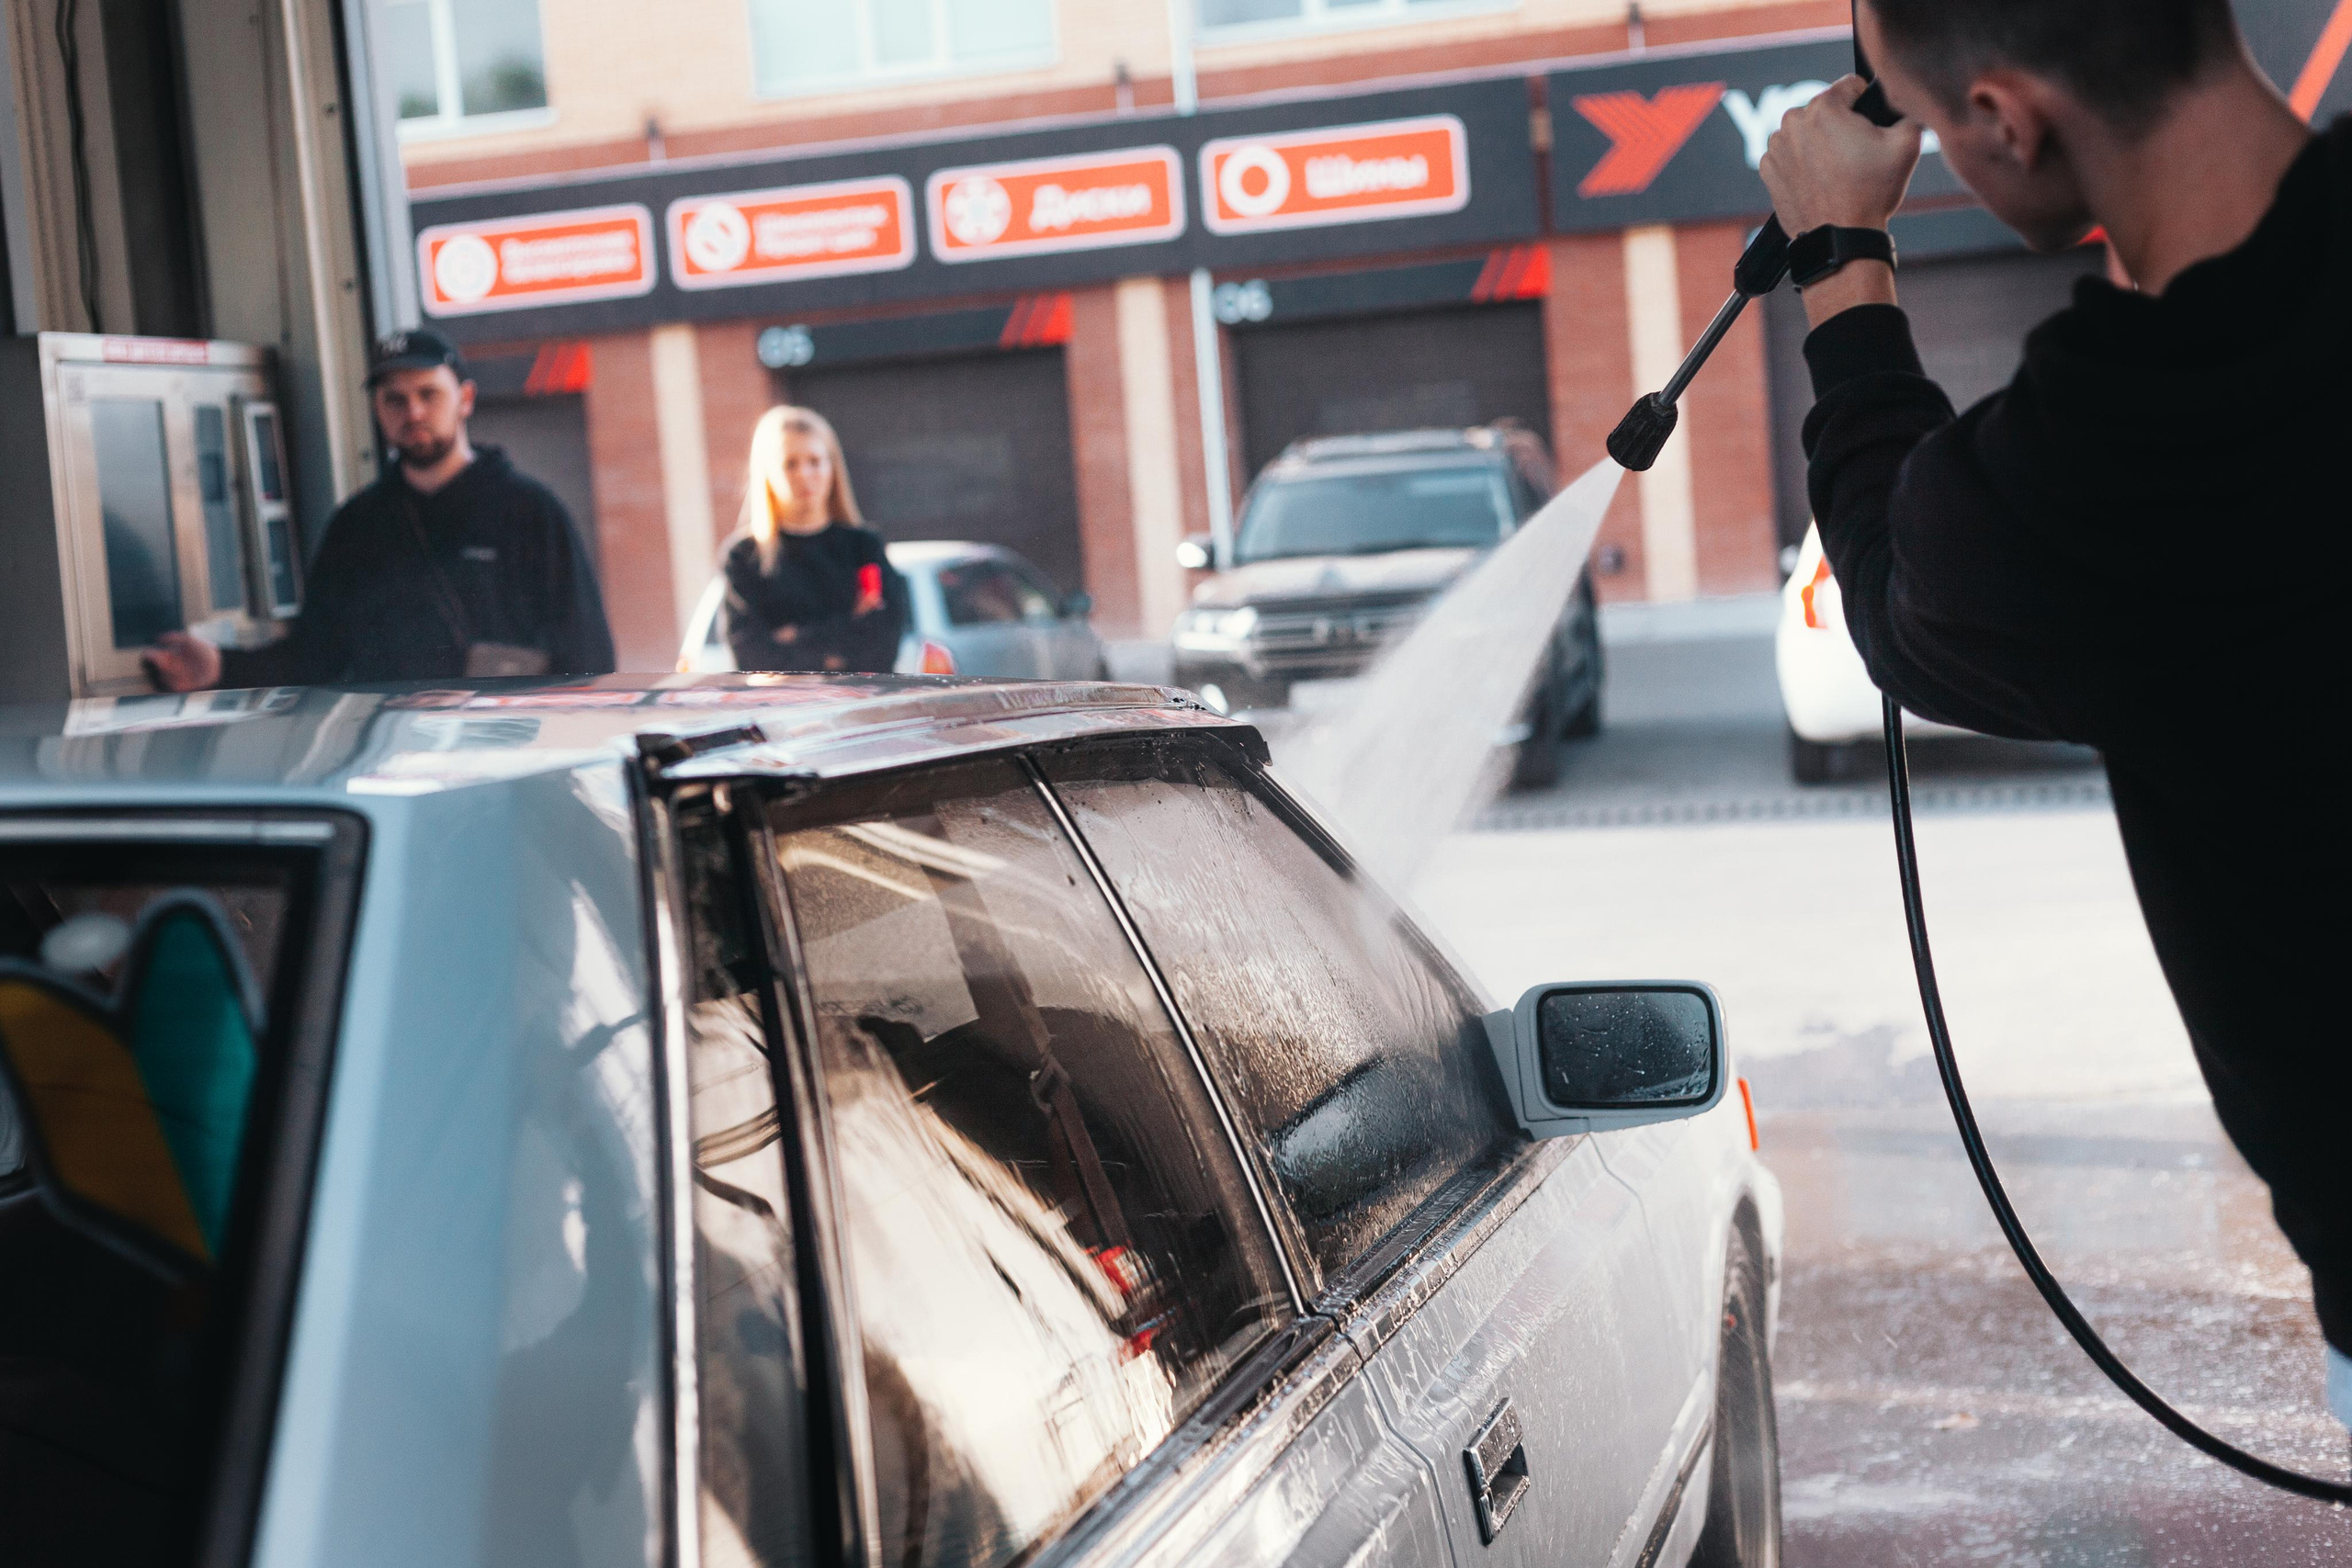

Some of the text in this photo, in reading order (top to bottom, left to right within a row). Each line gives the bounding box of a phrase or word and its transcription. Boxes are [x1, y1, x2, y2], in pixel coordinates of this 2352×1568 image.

[1306, 154, 1428, 198] Шины
[1030, 184, 1151, 232] Диски
[1215, 279, 1272, 323] 06
[759, 324, 814, 368] 05
